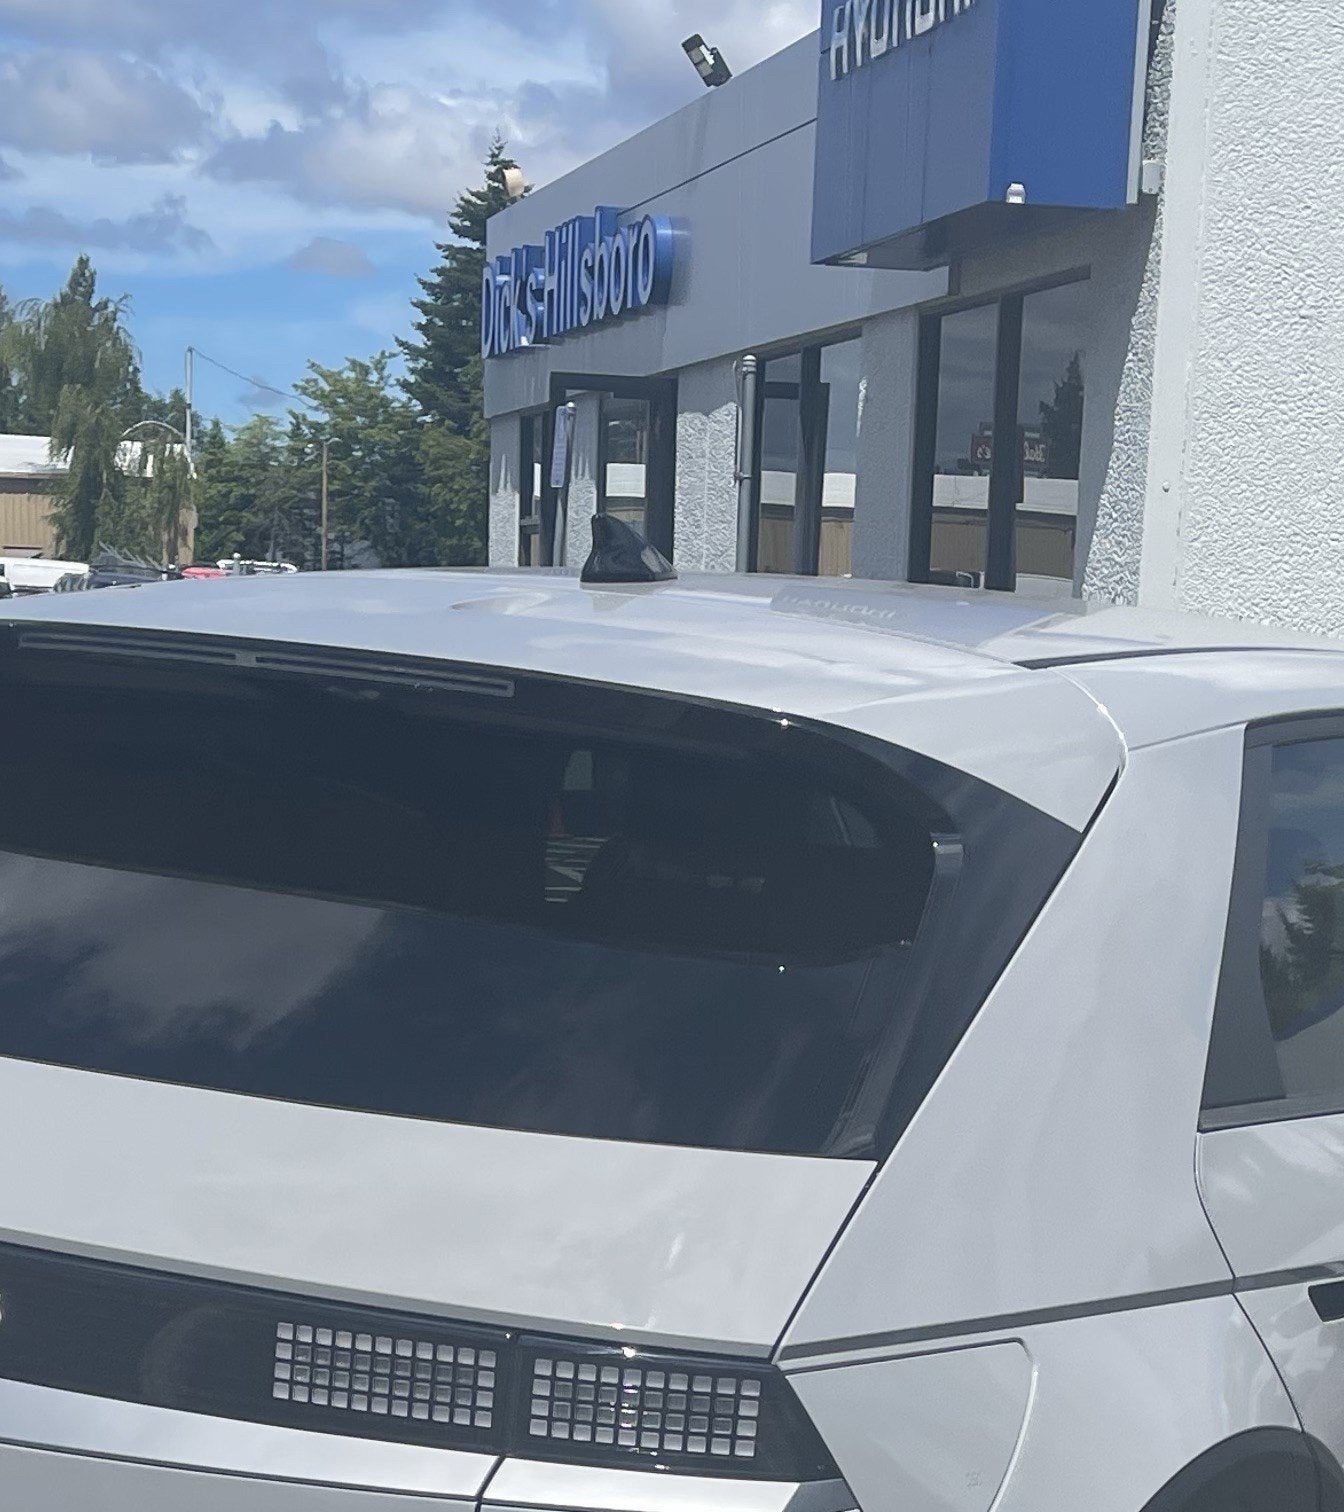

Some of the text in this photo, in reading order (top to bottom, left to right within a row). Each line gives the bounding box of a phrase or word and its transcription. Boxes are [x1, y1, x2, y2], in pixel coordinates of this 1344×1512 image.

[830, 0, 974, 80] HYUN
[482, 206, 656, 358] Dick's Hillsboro
